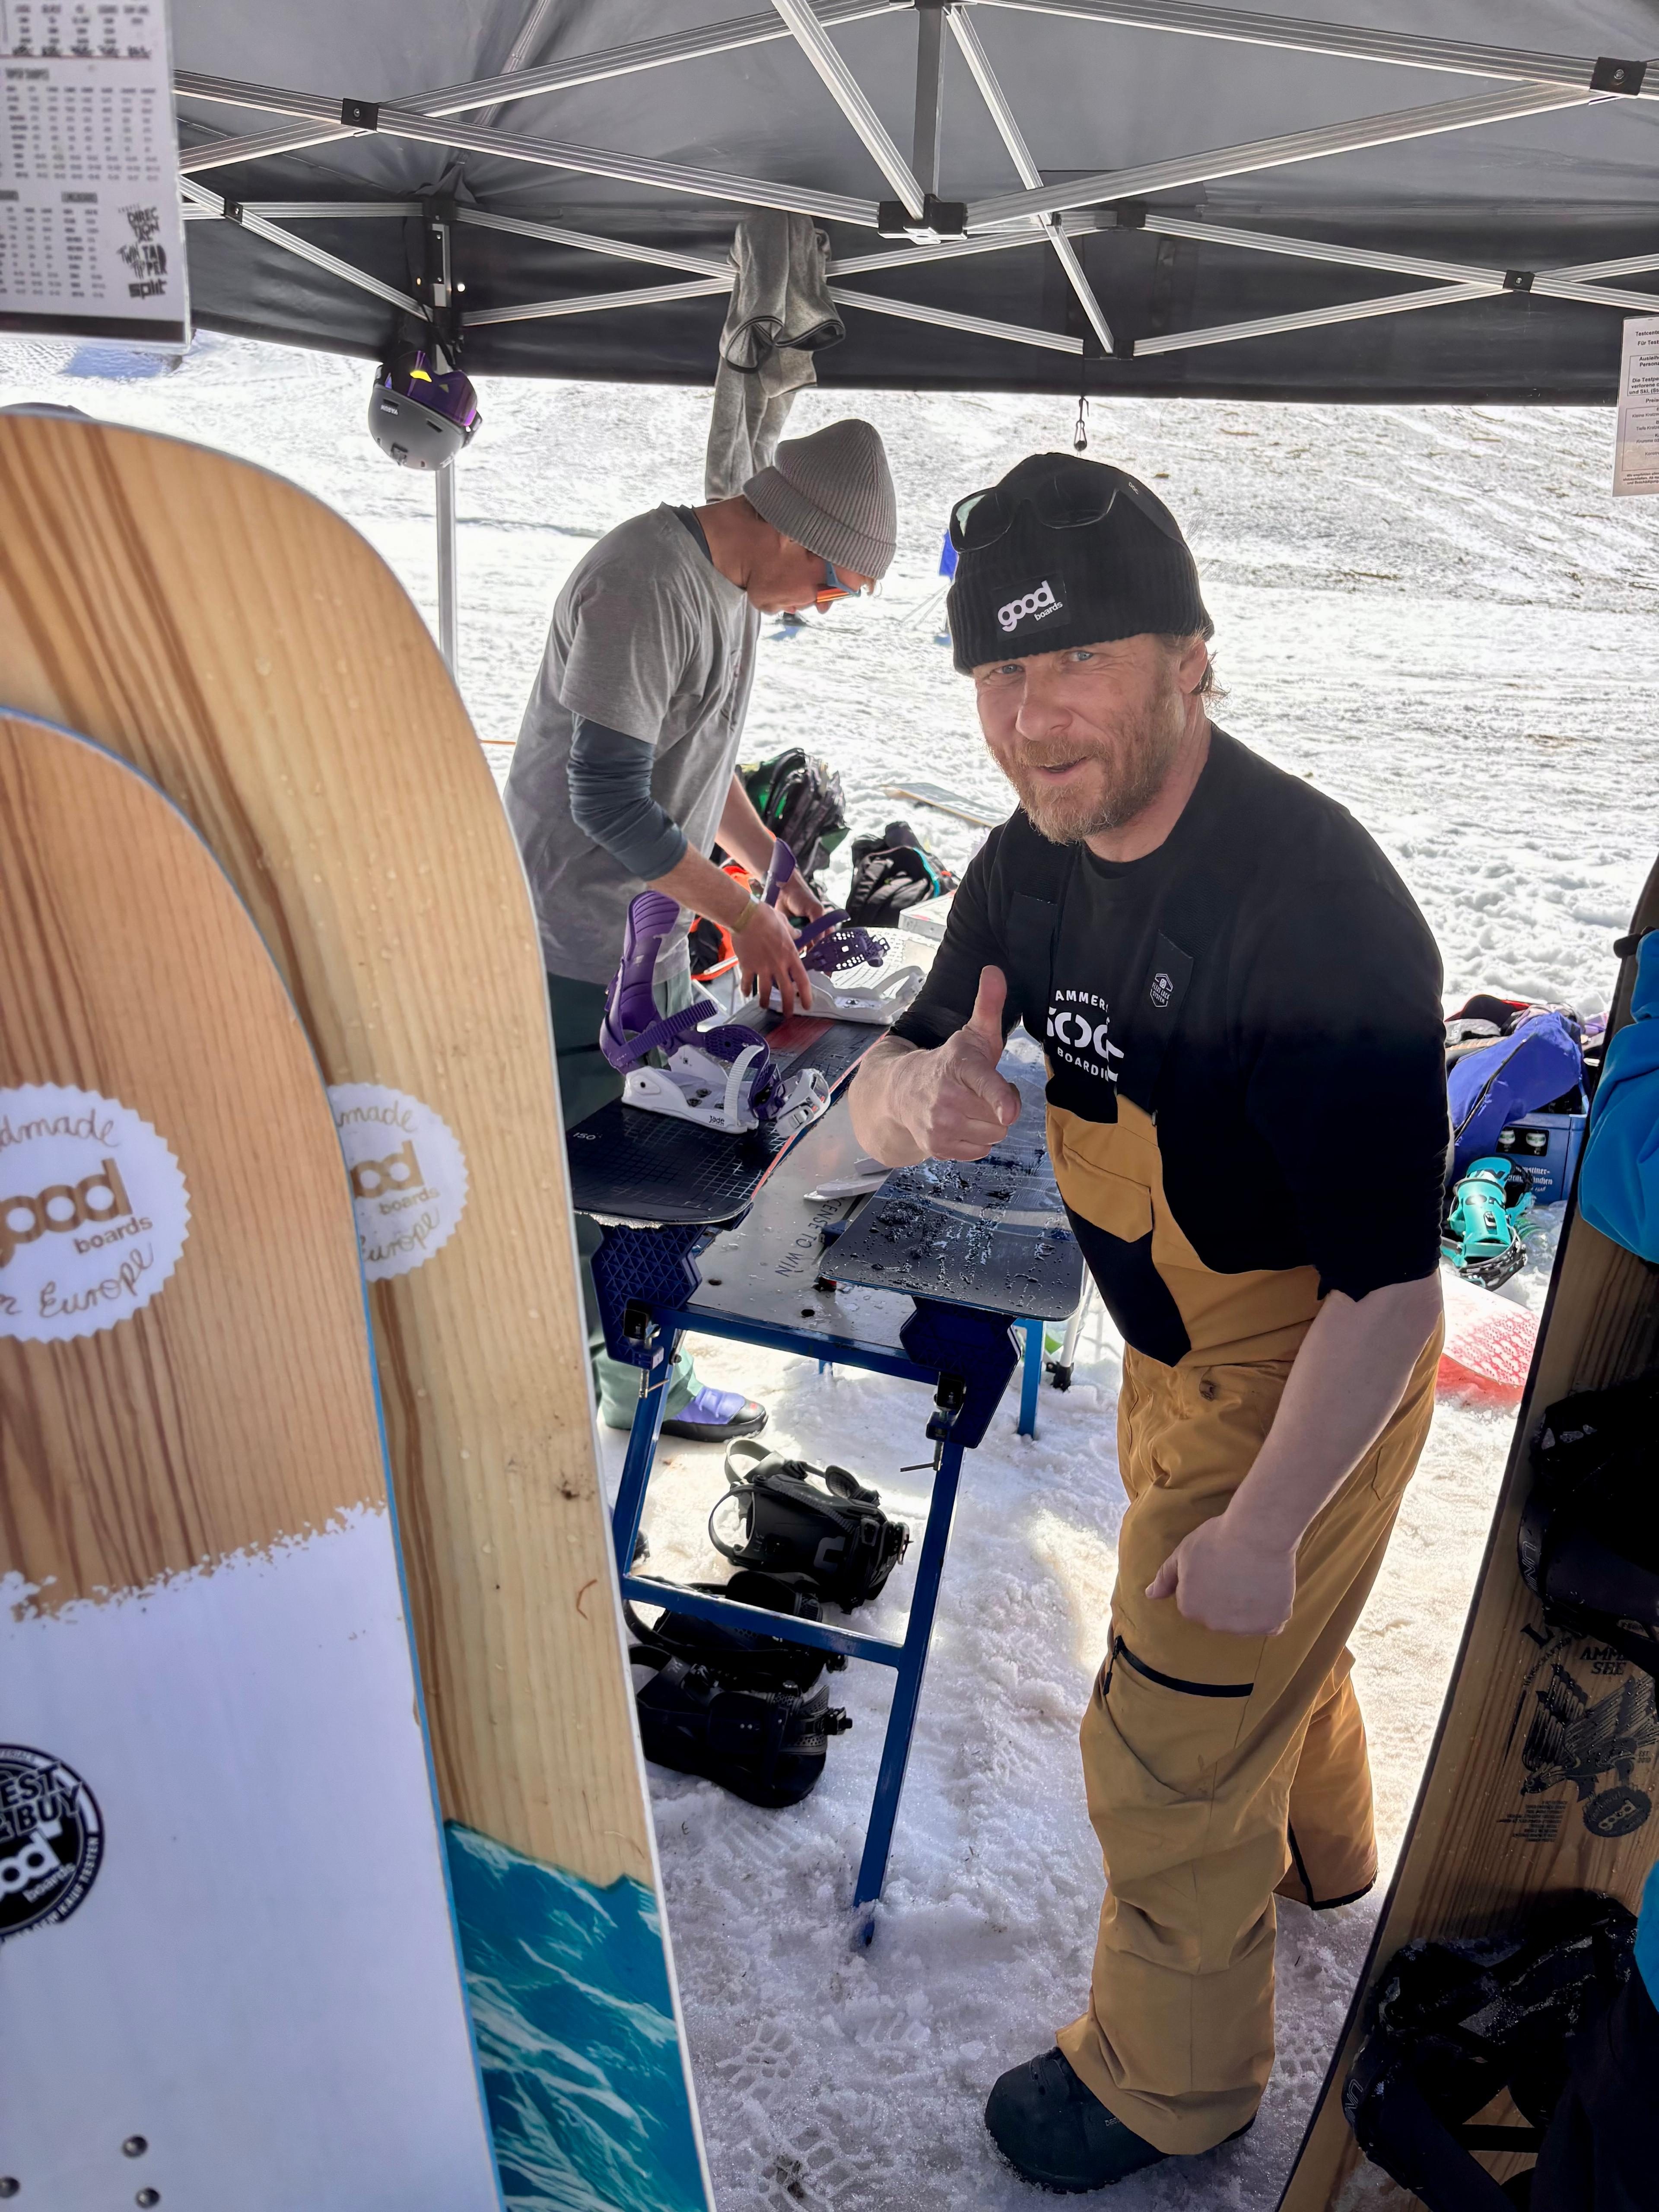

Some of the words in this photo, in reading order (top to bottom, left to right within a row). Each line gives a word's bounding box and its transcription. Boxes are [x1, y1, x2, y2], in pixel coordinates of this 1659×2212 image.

[128, 278, 167, 300] split
[997, 581, 1056, 632] good
[1034, 601, 1063, 622] boards
[1055, 990, 1109, 1013] AMMER
[0, 1109, 120, 1152] dmade
[338, 1100, 417, 1133] made
[350, 1139, 424, 1199] od
[379, 1187, 440, 1214] boards
[808, 1198, 842, 1233] CENSE
[74, 1216, 153, 1254] boards
[796, 1233, 818, 1248] TO
[40, 1242, 154, 1318] Europe
[775, 1252, 804, 1278] WIN
[1590, 1661, 1626, 1675] SEE
[0, 1762, 59, 1809] EST
[16, 1782, 82, 1835] BUY
[1598, 1799, 1637, 1831] good
[0, 1831, 61, 1900] od
[22, 1862, 76, 1904] boards
